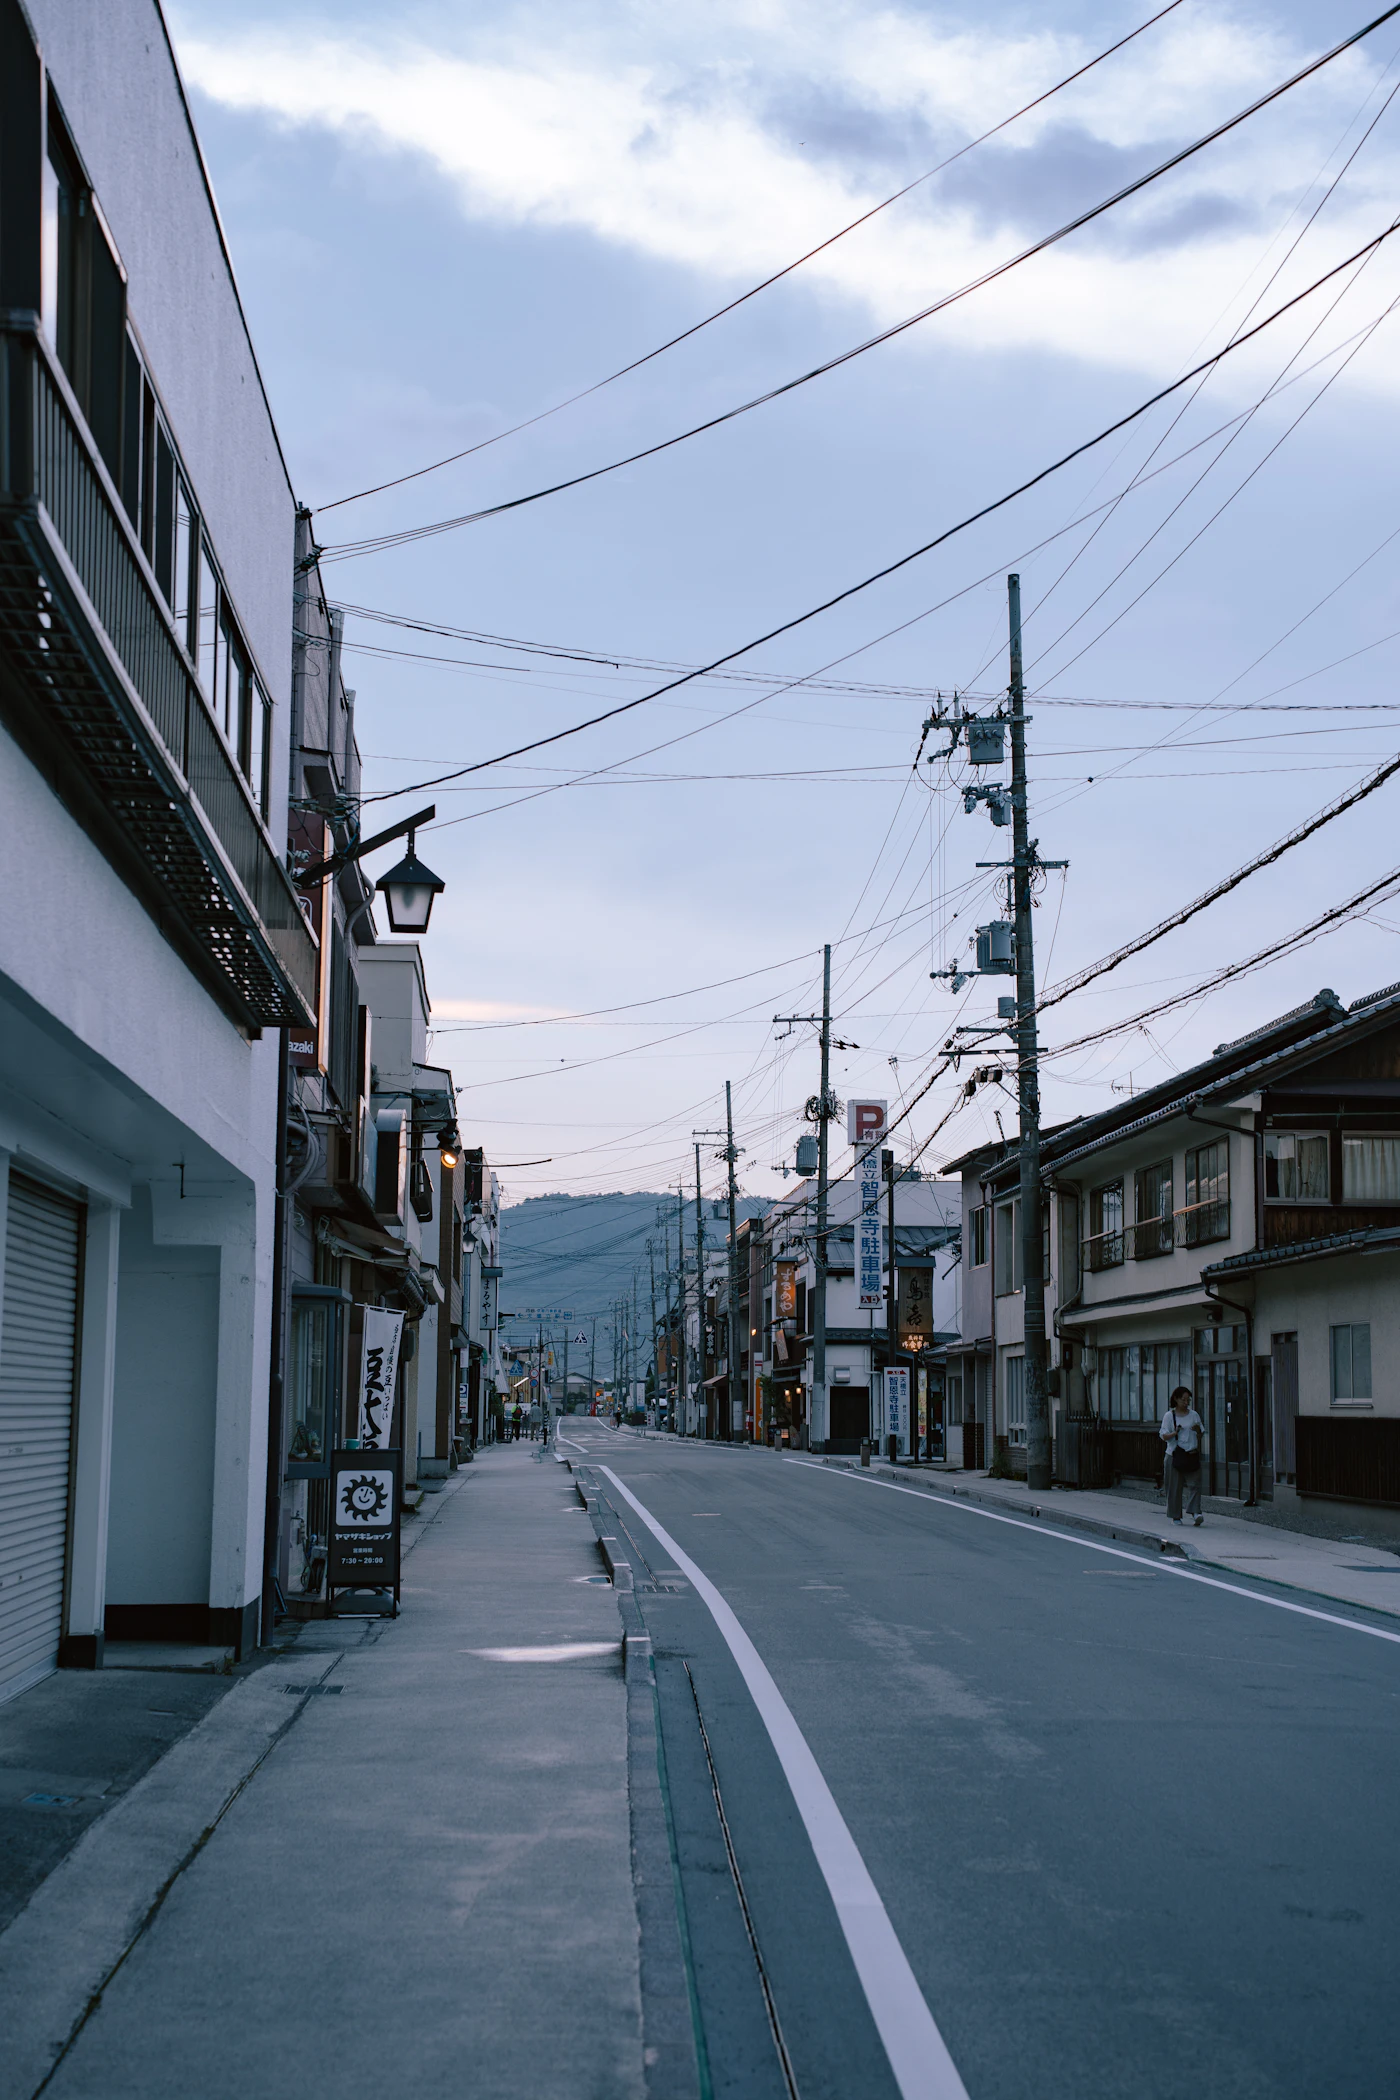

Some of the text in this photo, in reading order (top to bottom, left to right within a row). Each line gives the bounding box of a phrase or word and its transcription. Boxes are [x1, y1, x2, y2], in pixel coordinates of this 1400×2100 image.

[856, 1105, 884, 1140] P
[482, 1278, 491, 1327] まるやす
[334, 1532, 393, 1541] ヤマザキショップ
